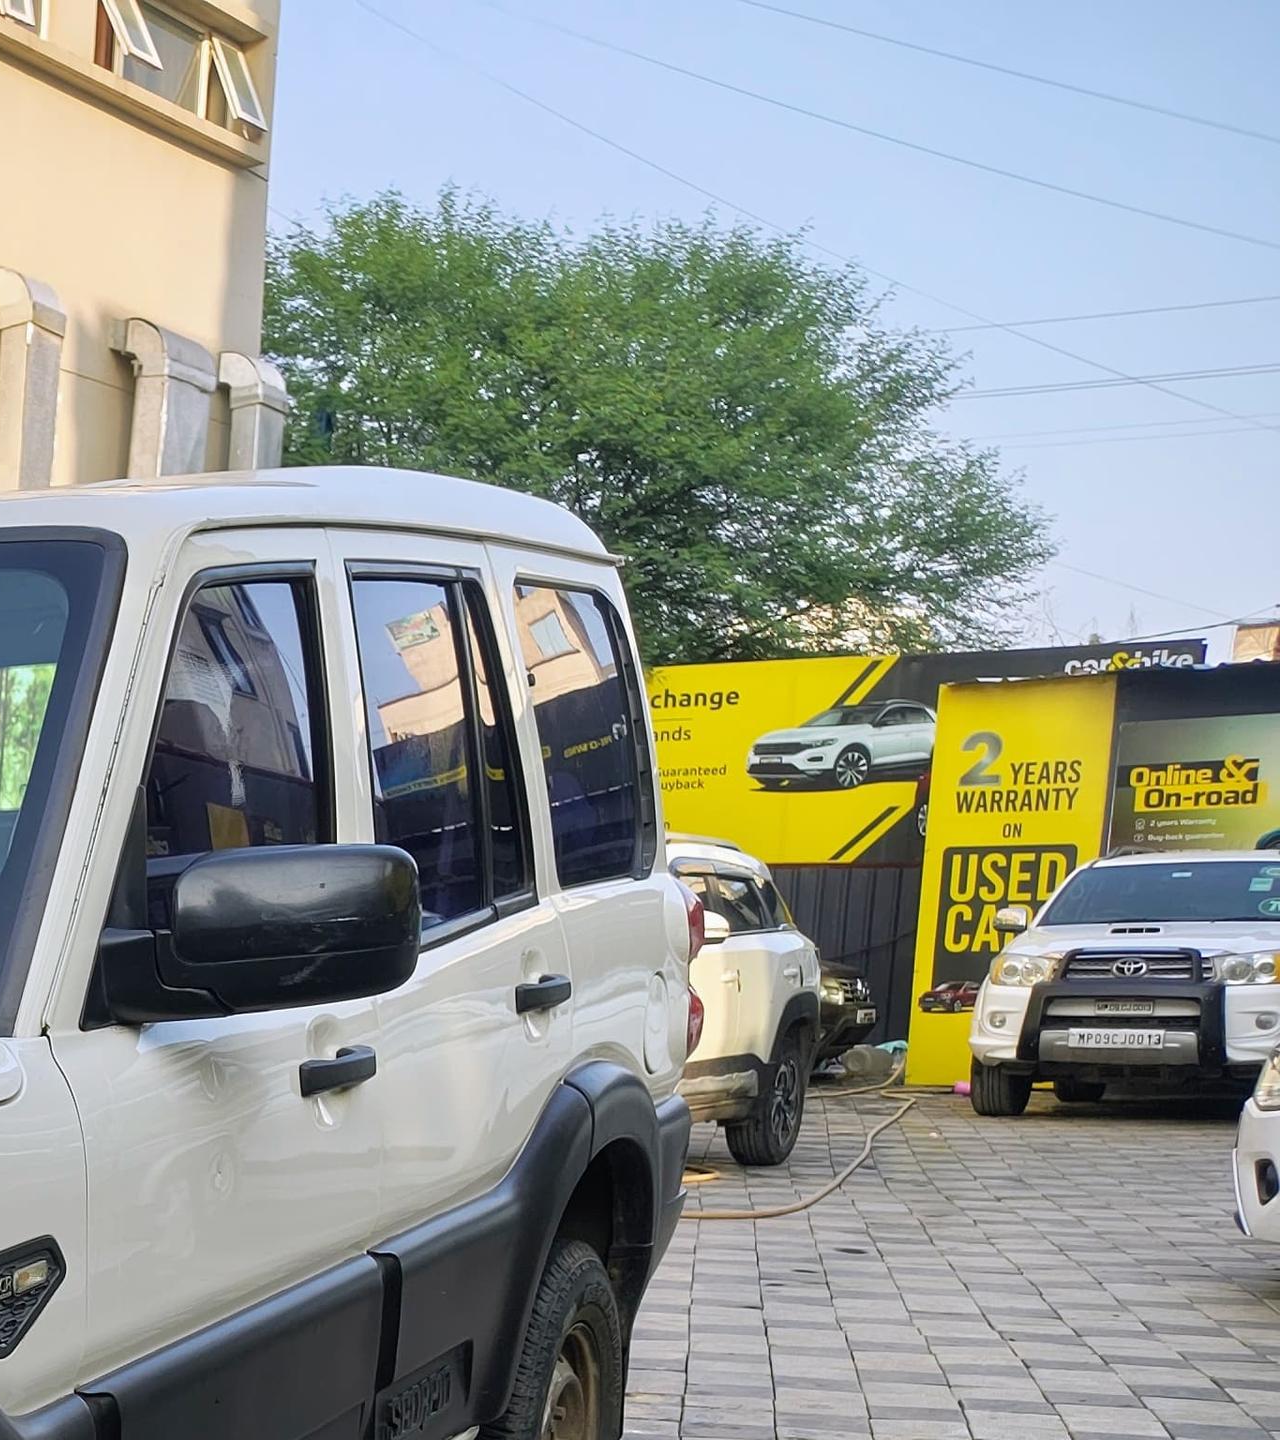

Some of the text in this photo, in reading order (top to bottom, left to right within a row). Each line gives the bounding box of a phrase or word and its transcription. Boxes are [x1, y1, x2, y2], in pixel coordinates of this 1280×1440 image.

[959, 731, 1083, 786] 2 YEARS
[1130, 754, 1259, 787] Online &
[956, 788, 1079, 814] WARRANTY
[1144, 784, 1259, 809] On-road
[1002, 823, 1023, 838] ON
[949, 852, 1068, 902] USED
[1077, 1032, 1162, 1046] MP09CJ0013
